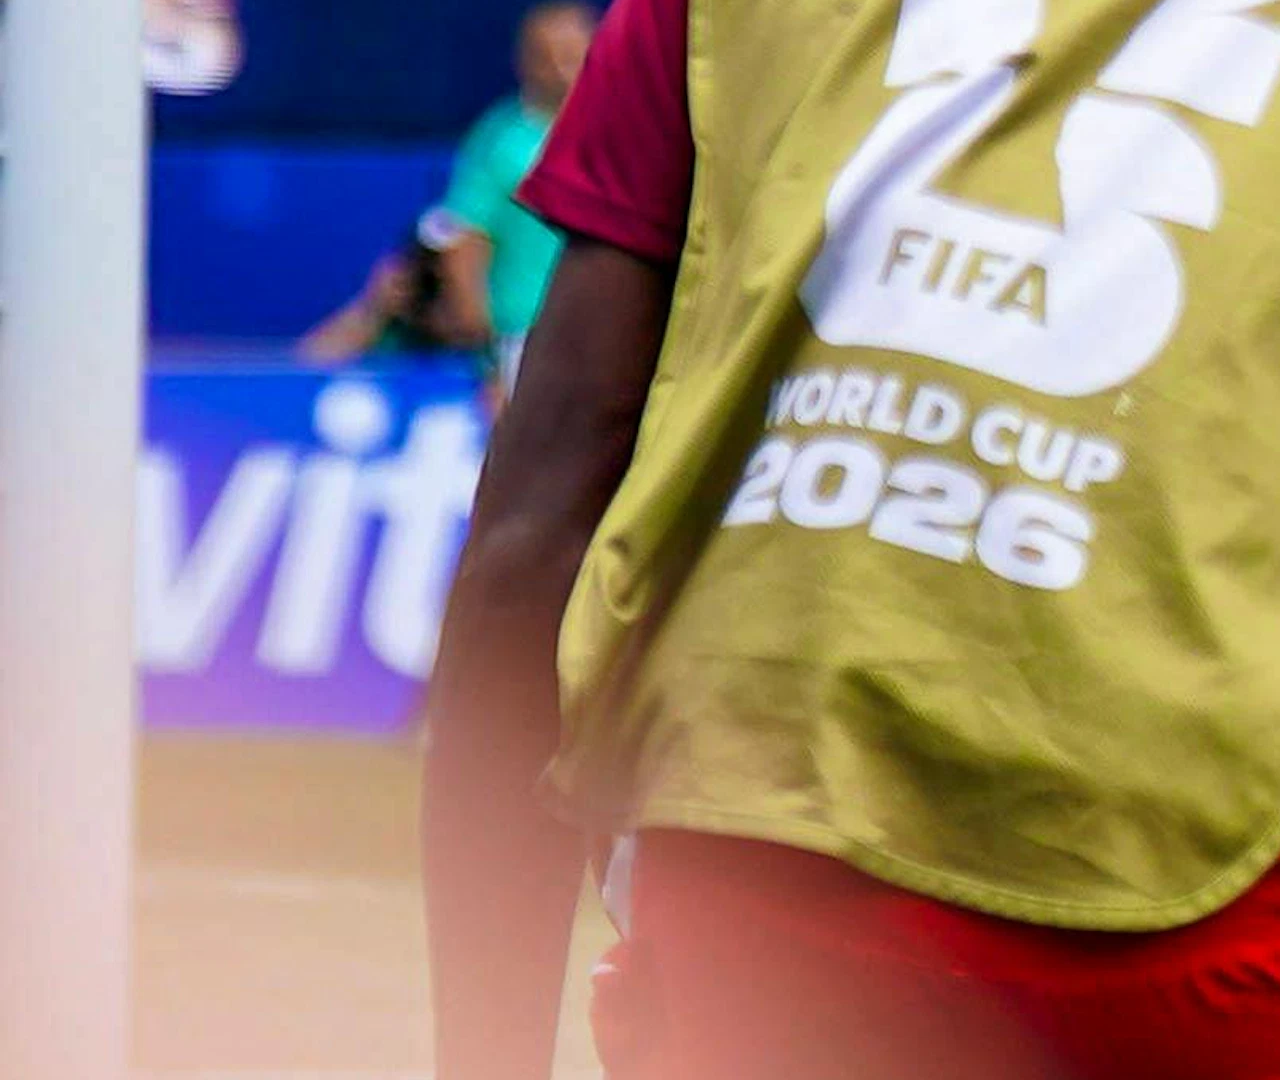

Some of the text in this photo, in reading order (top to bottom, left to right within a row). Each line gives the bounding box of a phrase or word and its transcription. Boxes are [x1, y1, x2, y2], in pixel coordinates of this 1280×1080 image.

[877, 227, 1049, 329] FIFA
[970, 405, 1125, 493] CUP
[721, 432, 1094, 592] 2026
